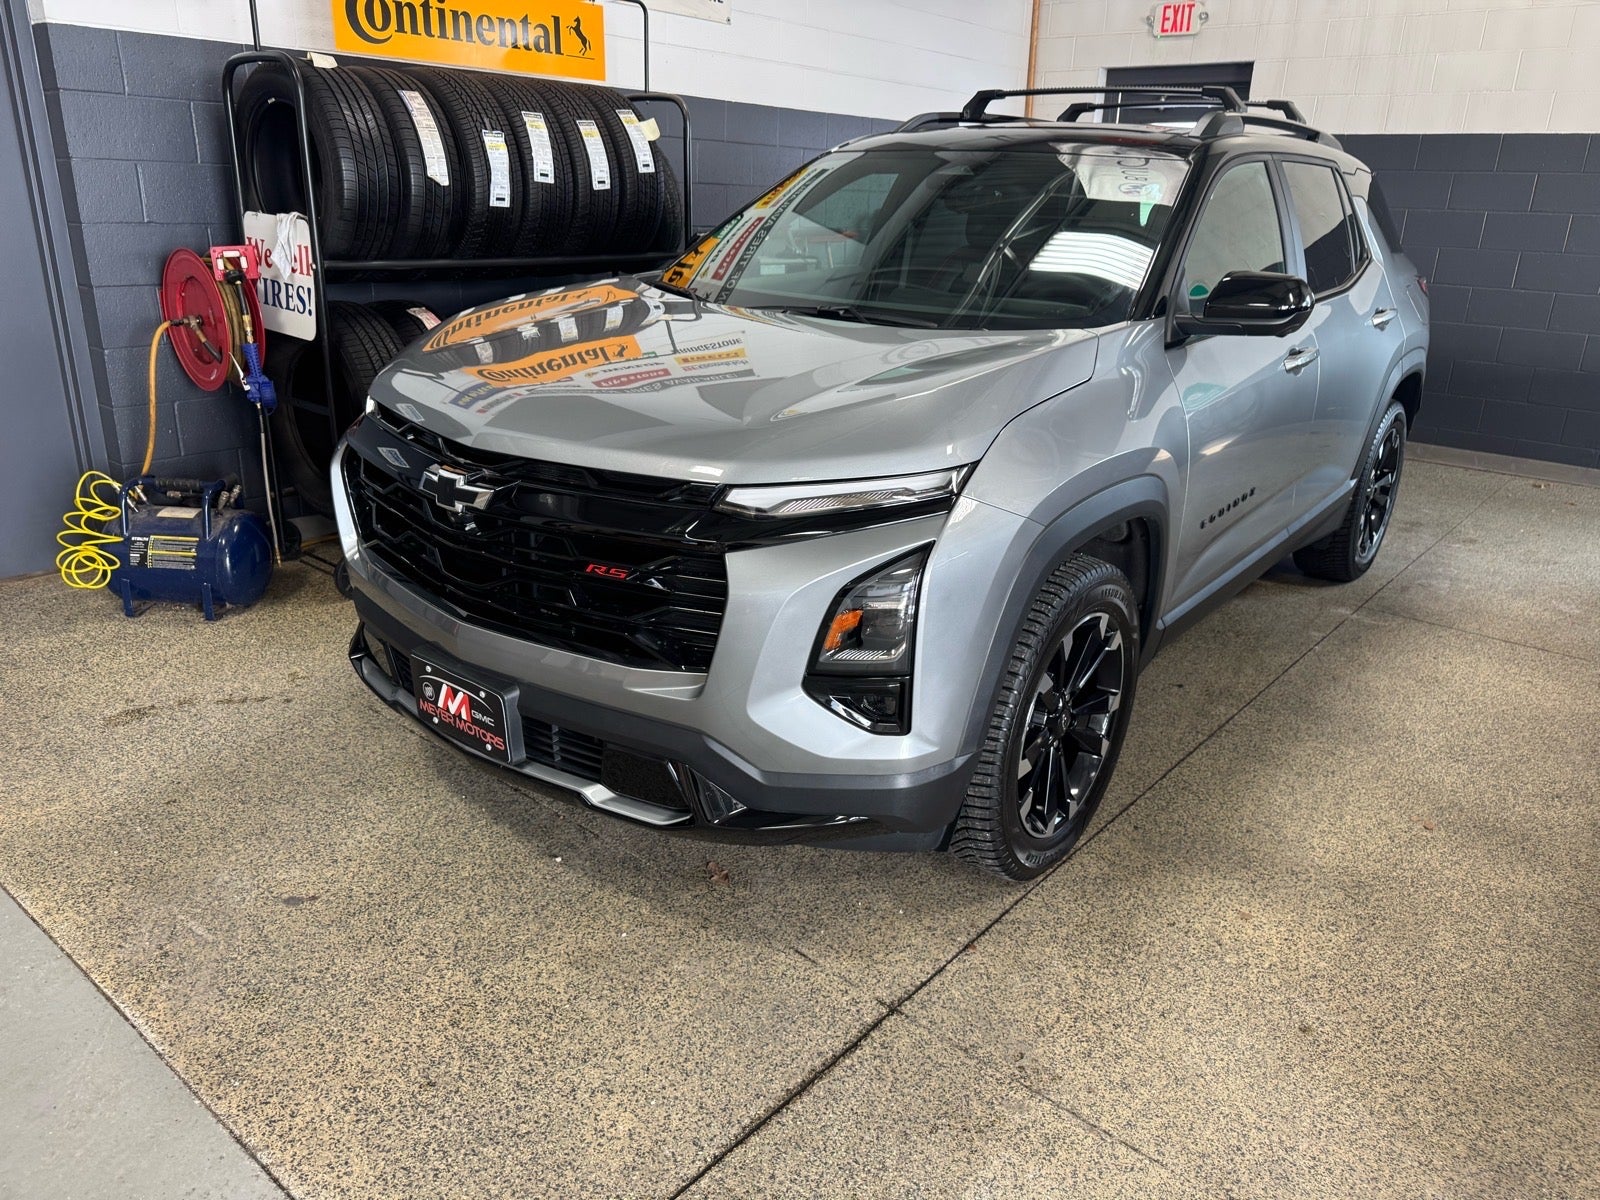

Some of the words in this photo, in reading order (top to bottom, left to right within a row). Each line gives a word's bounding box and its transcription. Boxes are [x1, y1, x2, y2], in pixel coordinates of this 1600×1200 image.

[345, 0, 564, 56] Continental
[1160, 4, 1196, 33] EXIT
[257, 273, 313, 317] IRES!
[586, 563, 629, 579] RS
[419, 698, 455, 727] MEYER
[456, 718, 505, 751] MOTORS
[471, 709, 495, 727] GMC
